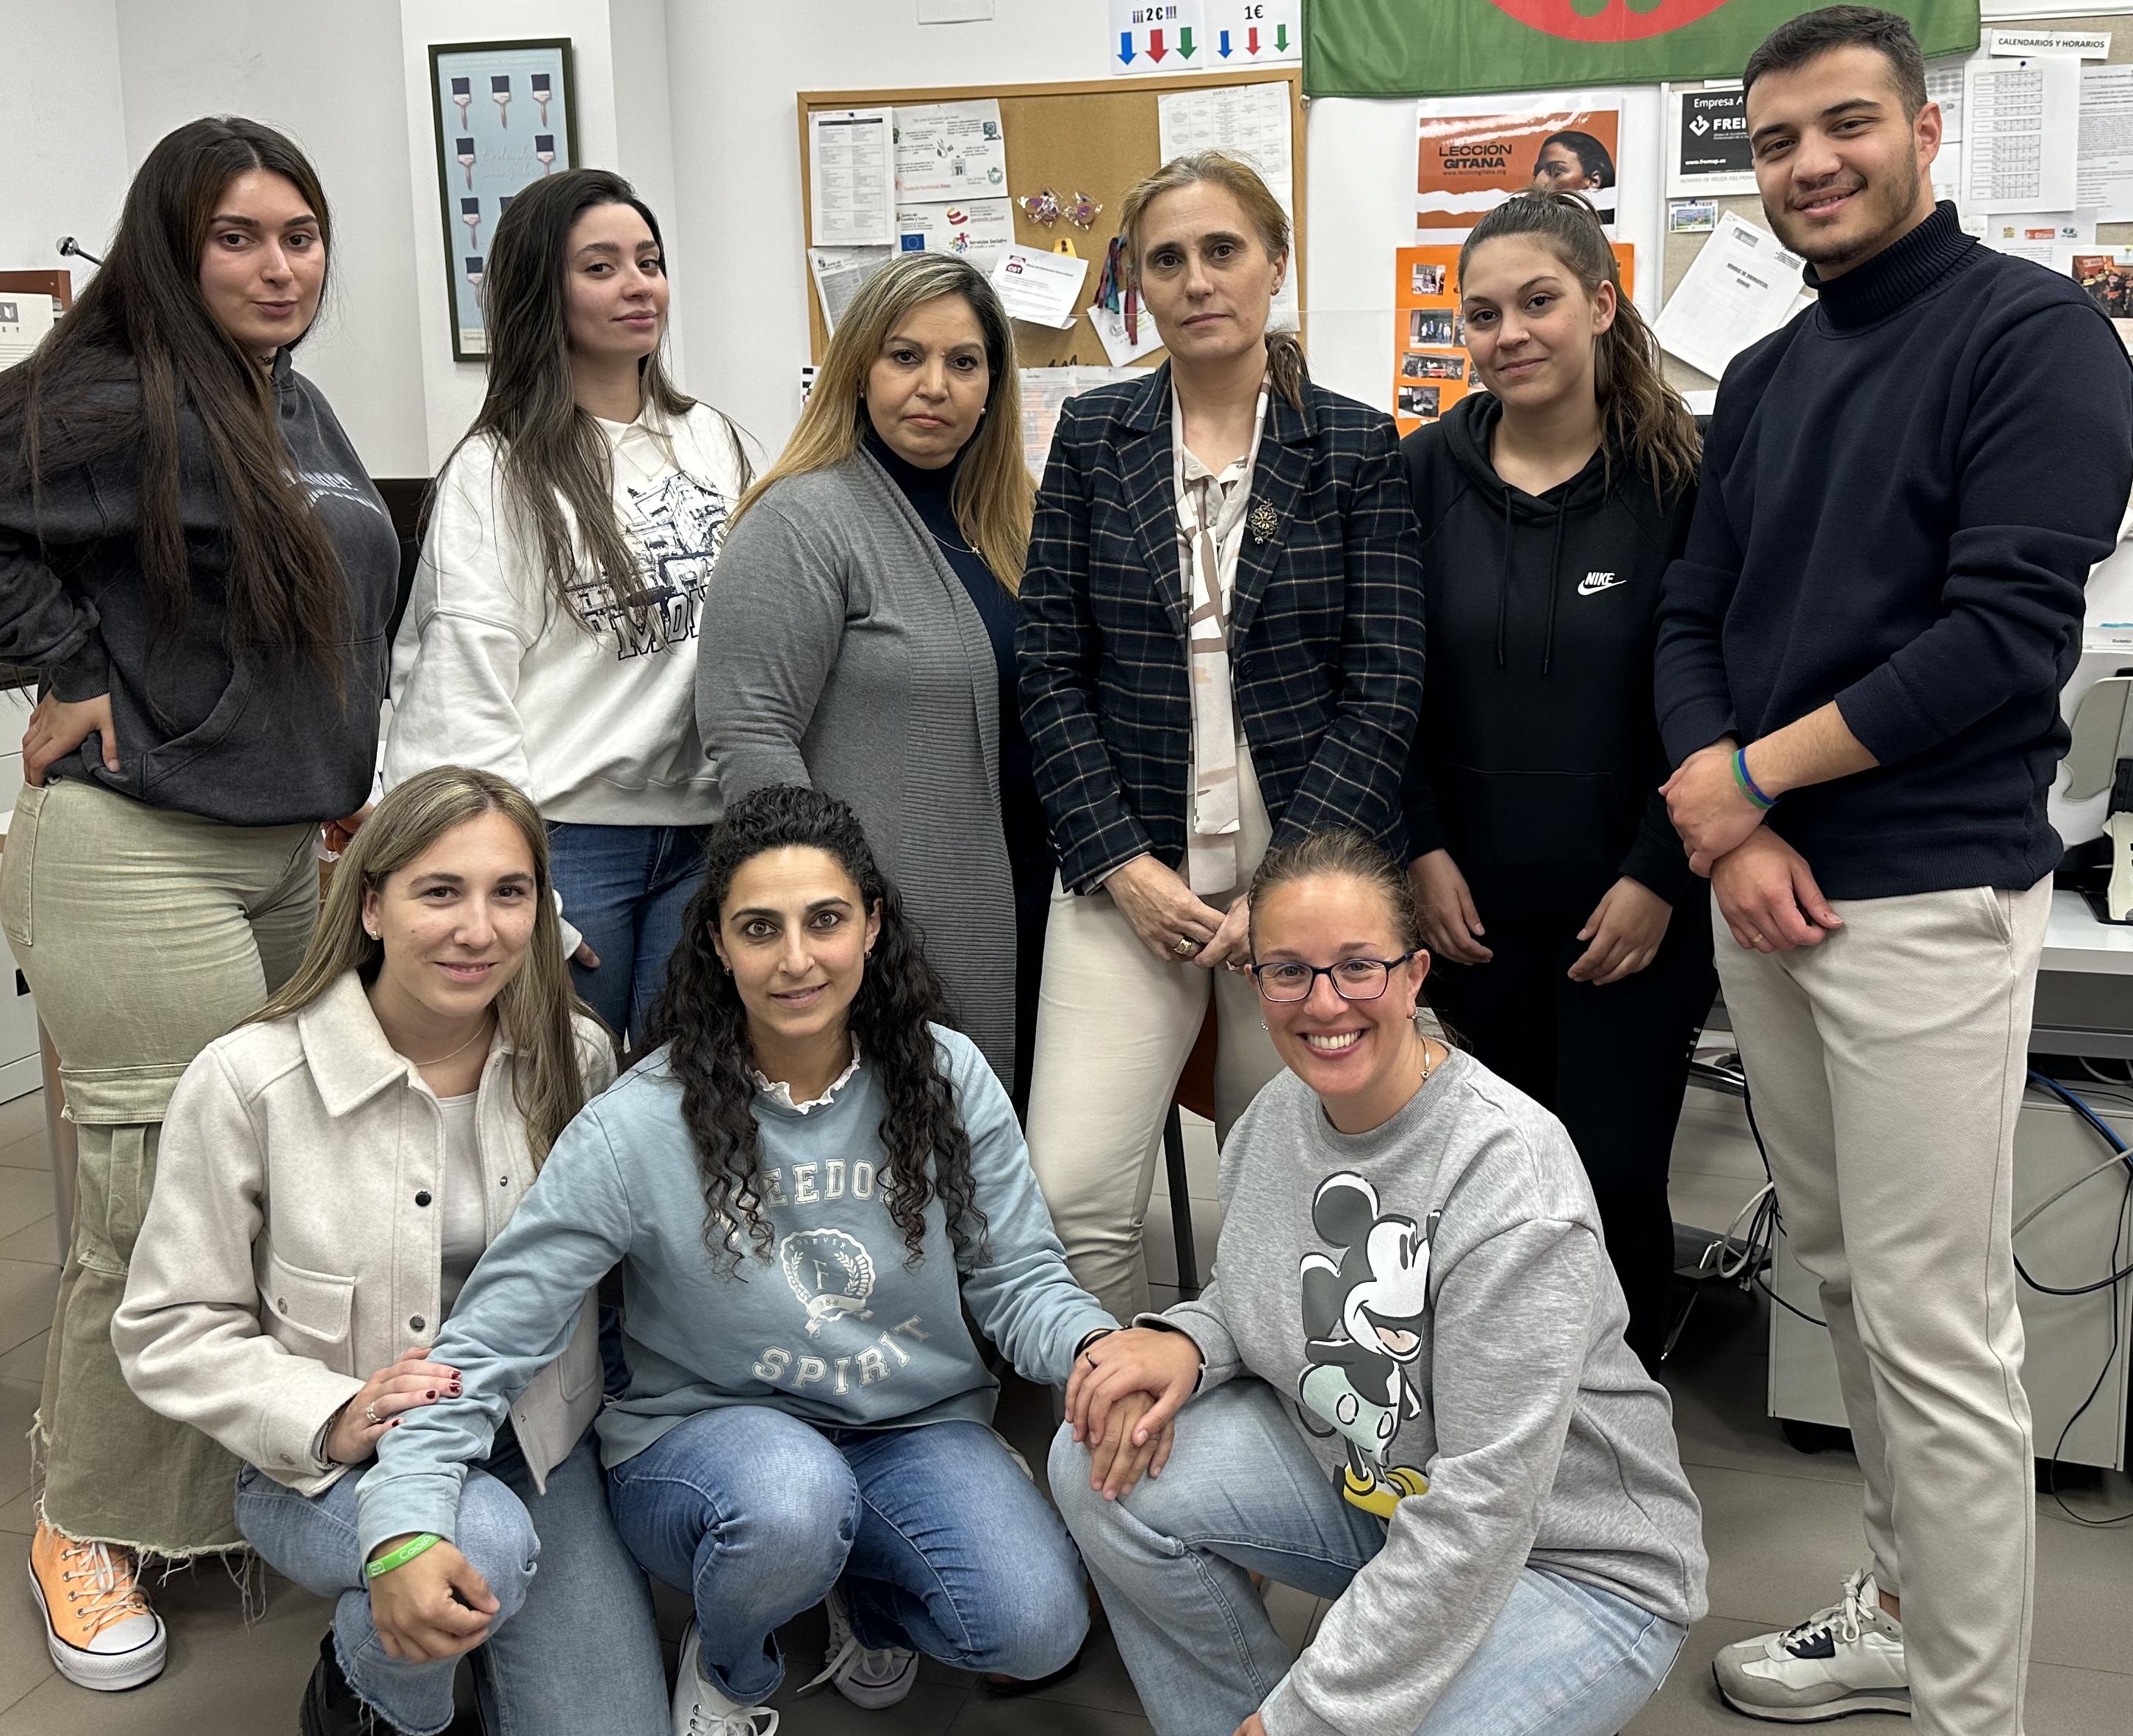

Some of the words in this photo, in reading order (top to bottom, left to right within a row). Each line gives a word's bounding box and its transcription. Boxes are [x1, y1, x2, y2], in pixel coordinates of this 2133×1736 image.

[1999, 38, 2054, 46] CALENDARIOS
[2062, 40, 2105, 48] HORARIOS
[1694, 98, 1734, 109] Empresa
[1439, 142, 1512, 156] LECCIÓN
[1443, 157, 1506, 169] GITANA
[1584, 572, 1615, 586] NIKE
[752, 1314, 932, 1396] SPIRIT
